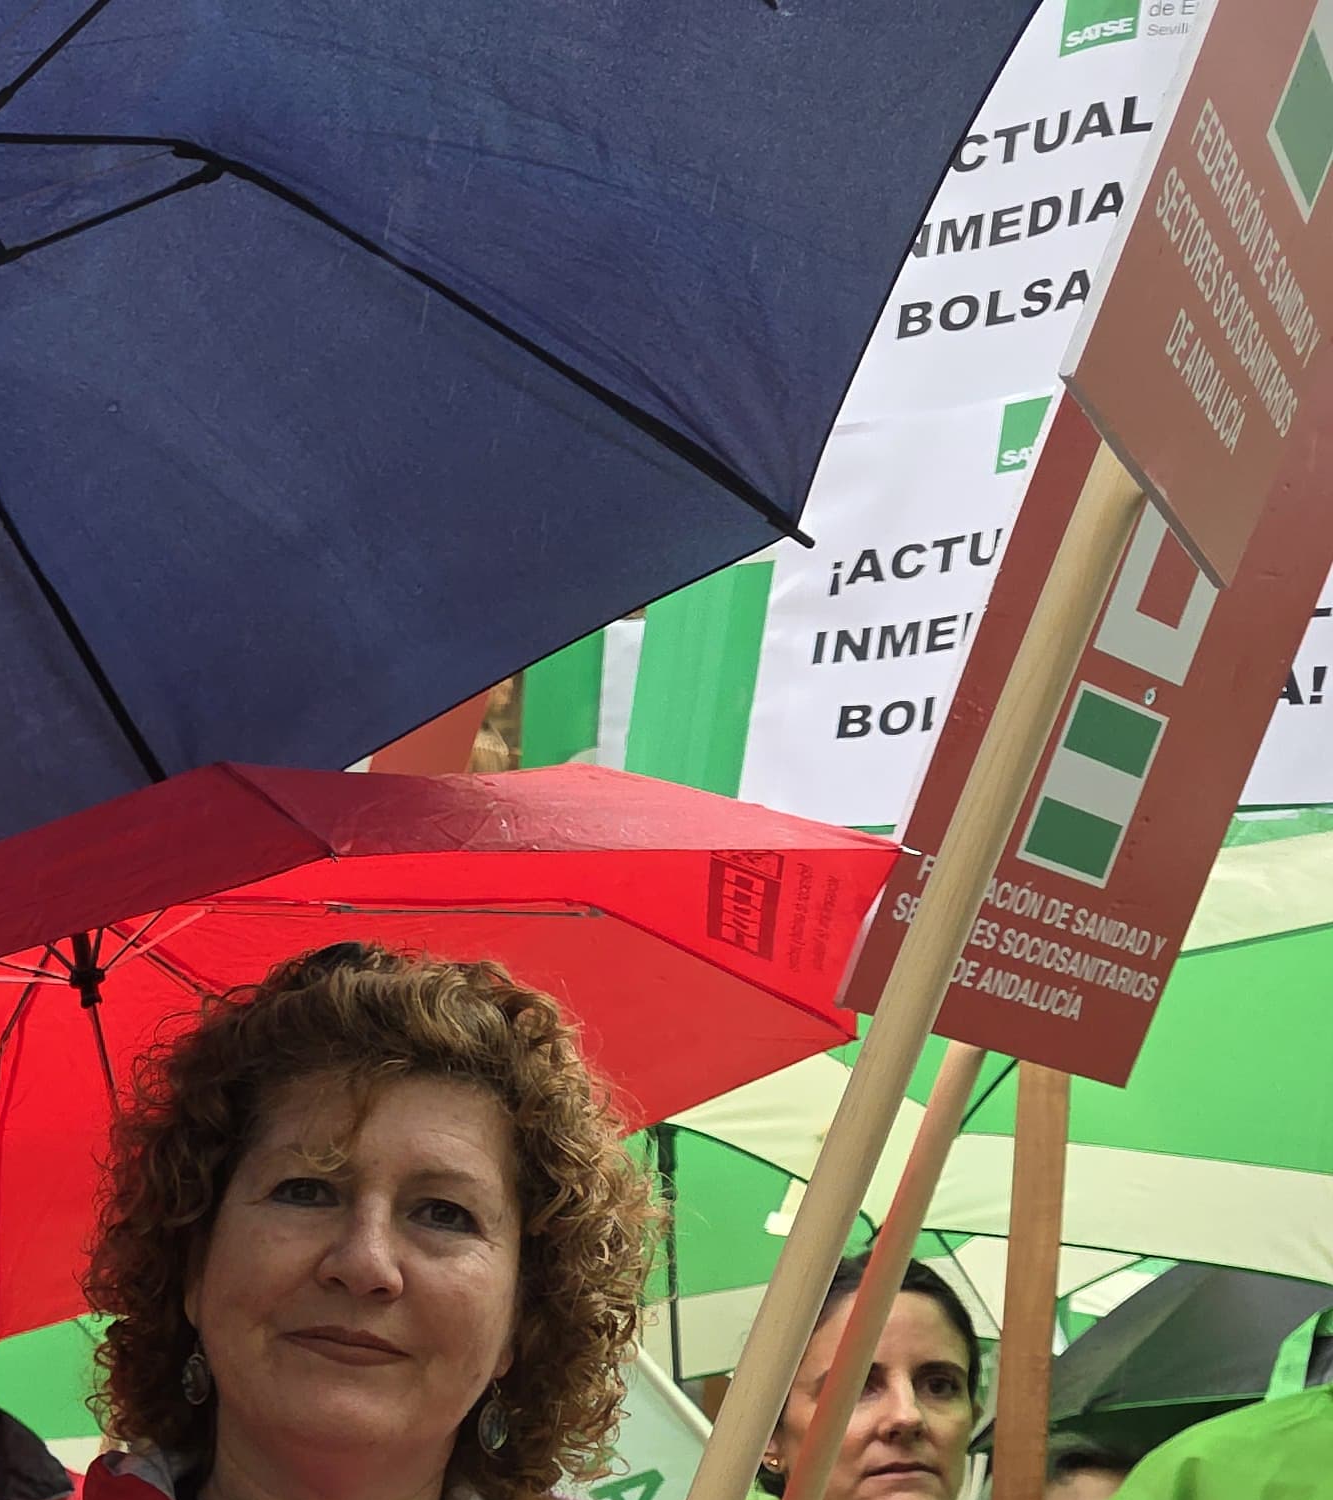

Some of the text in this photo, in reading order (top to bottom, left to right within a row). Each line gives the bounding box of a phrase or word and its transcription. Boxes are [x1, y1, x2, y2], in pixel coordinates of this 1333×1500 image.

[1065, 17, 1136, 47] SATSE
[1146, 23, 1191, 37] Sevill
[951, 96, 1154, 173] CTUAL
[1191, 97, 1321, 369] FEDERACIÓN DE SANIDAD Y
[896, 269, 1091, 340] BOLSA
[1156, 166, 1299, 438] SECTORES SOCIOSANITARIOS
[1164, 308, 1248, 455] DE ANDALUCÍA
[828, 528, 1004, 597] ¡ACTU
[811, 612, 974, 665] INME
[1042, 898, 1074, 930] DE
[1070, 908, 1151, 957] SANIDAD
[1151, 934, 1168, 961] Y
[950, 957, 1084, 1021] DE ANDALUCÍA
[998, 928, 1160, 1002] SOCIOSANITARIOS
